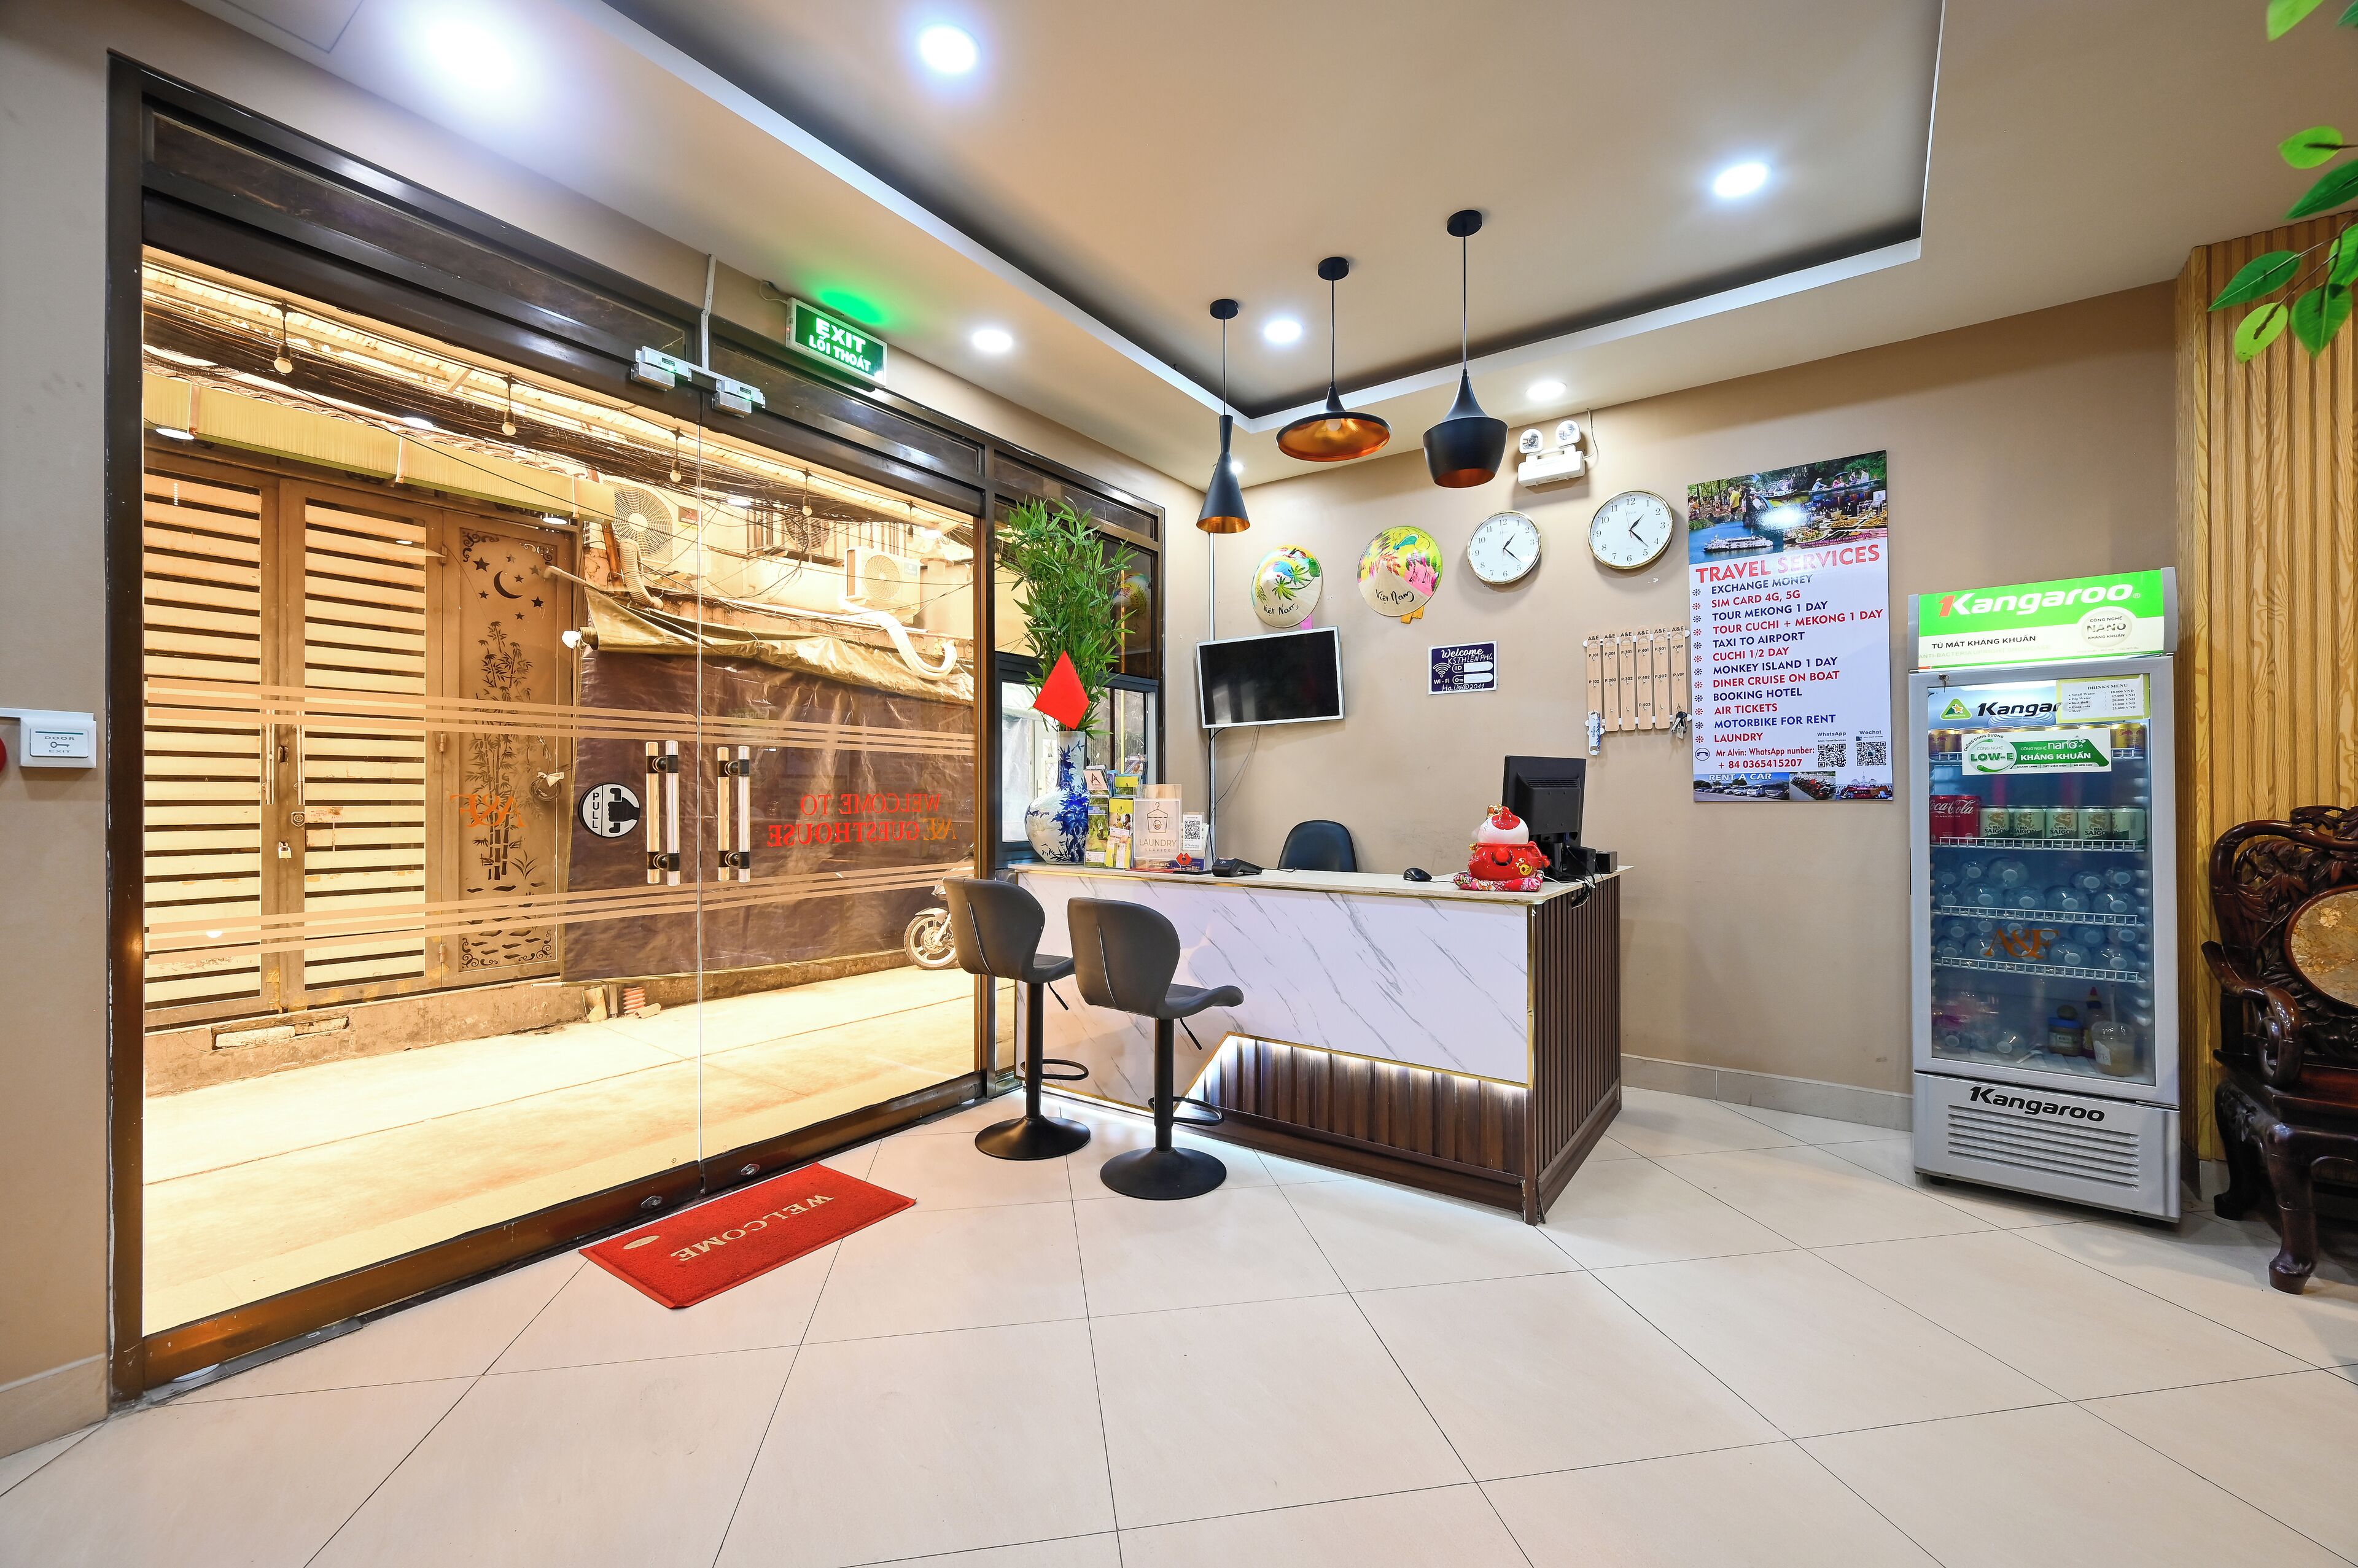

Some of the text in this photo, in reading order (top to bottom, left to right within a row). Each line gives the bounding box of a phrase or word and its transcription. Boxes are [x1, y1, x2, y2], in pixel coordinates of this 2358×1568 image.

[816, 317, 866, 354] EXIT
[833, 344, 871, 372] THOÁT
[1695, 545, 1880, 583] TRAVEL SERVICES
[1711, 574, 1813, 594] EXCHANGE MONEY
[1711, 589, 1800, 608] SIM CARD 4G, 5G
[1712, 600, 1828, 621] TOUR MEKONG 1 DAY
[1713, 624, 1742, 634] TOUR
[1745, 620, 1779, 631] CUCHI
[1795, 613, 1845, 627] MEKONG
[1850, 612, 1854, 621] 1
[1860, 608, 1883, 620] DAY
[2087, 623, 2126, 632] NANO
[1713, 631, 1805, 648] TAXI TO AIRPORT
[1967, 638, 1999, 646] KHÁNG
[1441, 648, 1484, 659] Welcome
[1713, 646, 1789, 661] CUCHI 1/2 DAY
[1713, 656, 1838, 674] MONKEY ISLAND 1 DAY
[1713, 670, 1840, 688] DINER CRUISE ON BOAT
[1713, 688, 1802, 701] BOOKING HOTEL
[1714, 703, 1778, 715] AIR TICKETS
[1714, 714, 1836, 729] MOTORBIKE FOR RENT
[1714, 732, 1764, 743] LAUNDRY
[2048, 740, 2077, 750] nano
[1749, 747, 1784, 757] WhatsApp
[1971, 752, 2014, 761] LOW-E
[2056, 750, 2091, 759] KHUẨN
[1743, 759, 1802, 768] 0365415207
[671, 1194, 835, 1262] WELCOME
